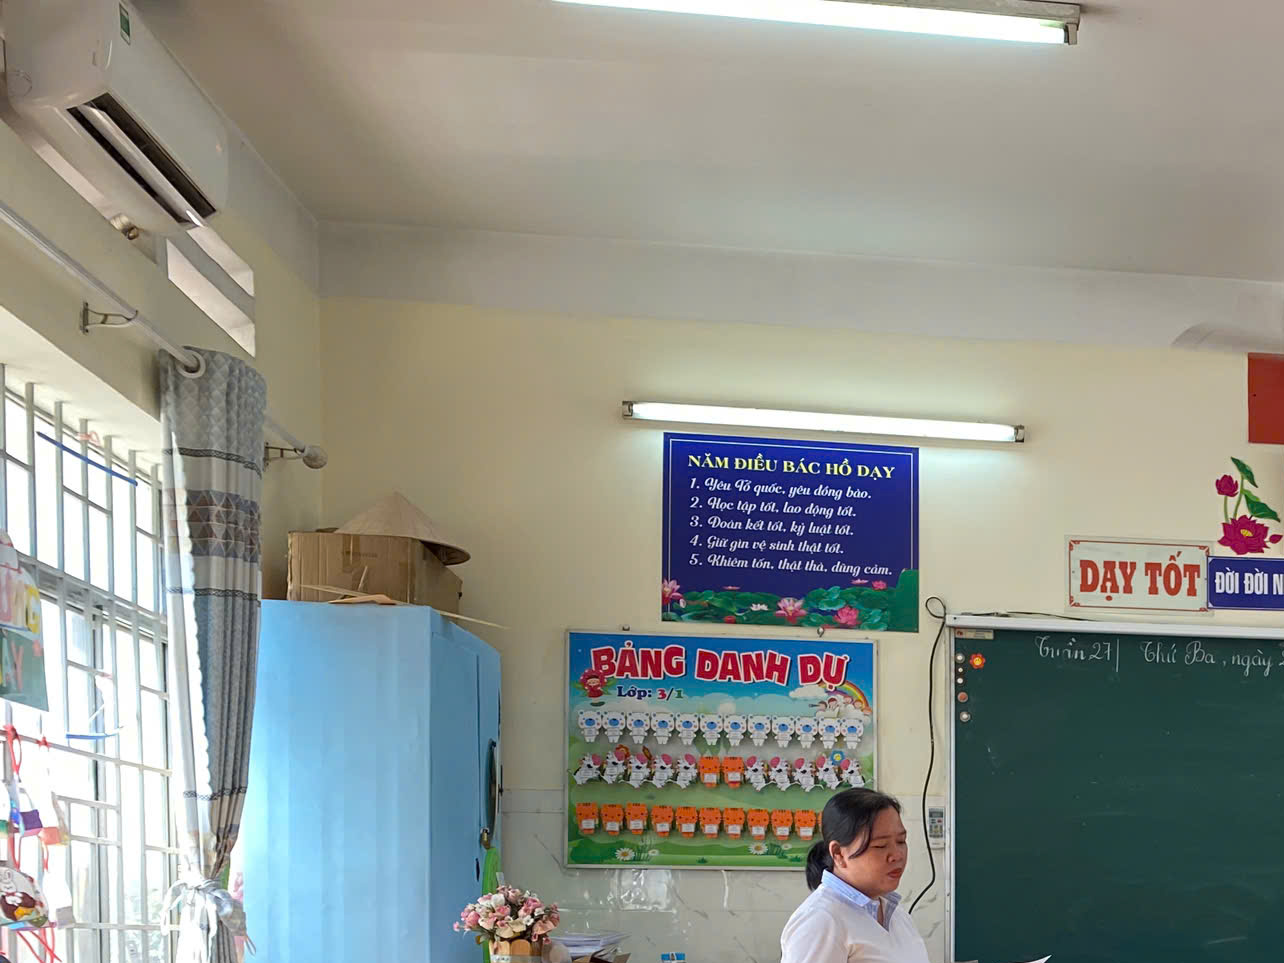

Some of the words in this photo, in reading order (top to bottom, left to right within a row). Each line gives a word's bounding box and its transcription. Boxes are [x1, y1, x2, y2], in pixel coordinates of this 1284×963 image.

[688, 453, 729, 469] NĂM
[734, 453, 777, 472] ĐIỀU
[783, 458, 821, 474] BÁC
[825, 458, 852, 476] HỒ
[857, 465, 895, 480] DẠY
[690, 478, 700, 489] 1.
[704, 477, 732, 491] Yêu
[734, 479, 752, 492] Tổ
[788, 485, 811, 498] yêu
[813, 484, 843, 501] đồng
[846, 486, 872, 499] bào.
[690, 496, 703, 508] 2.
[707, 496, 734, 512] Học
[737, 500, 756, 515] tập
[783, 501, 802, 513] lao
[804, 503, 834, 519] động
[837, 506, 856, 517] tốt.
[689, 515, 703, 527] 3.
[707, 515, 742, 529] Đoàn
[745, 518, 764, 531] kết
[808, 522, 832, 536] luật
[834, 524, 854, 535] tốt.
[689, 534, 702, 546] 4.
[707, 535, 729, 549] Giữ
[752, 540, 767, 552] vệ
[769, 540, 795, 551] sinh
[798, 540, 822, 554] thật
[825, 542, 844, 554] tốt.
[689, 553, 703, 566] 5.
[707, 554, 748, 568] Khiêm
[778, 558, 802, 572] thật
[831, 561, 861, 577] dũng
[864, 564, 892, 575] cảm.
[1079, 559, 1136, 601] DẠY
[1144, 551, 1201, 597] TỐT
[1215, 567, 1240, 594] ĐỜI
[1244, 568, 1269, 595] ĐỜI
[1035, 636, 1085, 660] Tuần
[1088, 641, 1111, 661] 27
[1140, 641, 1177, 664] Thứ
[1231, 649, 1272, 677] ngày
[591, 640, 686, 680] BẢNG
[695, 649, 791, 686] DANH
[798, 652, 850, 691] DỰ
[617, 686, 652, 700] Lớp:
[657, 687, 684, 700] 3/1
